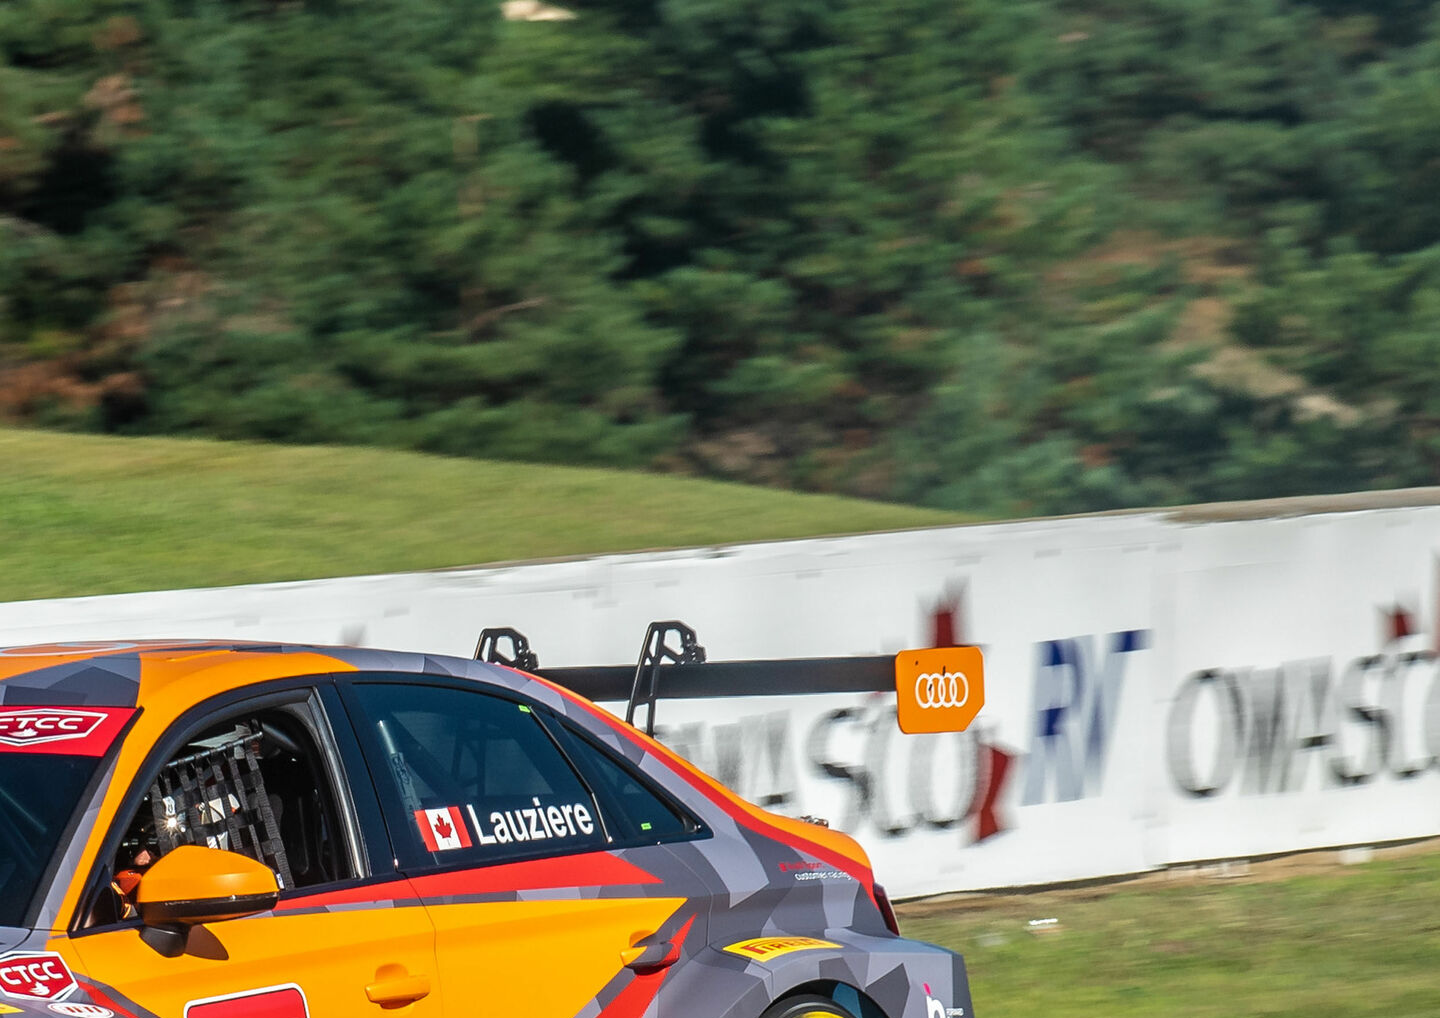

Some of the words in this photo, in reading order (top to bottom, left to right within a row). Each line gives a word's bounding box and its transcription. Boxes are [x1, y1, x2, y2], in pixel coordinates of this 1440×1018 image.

[658, 706, 988, 838] WASCO
[1022, 629, 1152, 806] RV
[466, 797, 594, 845] Lauziere
[0, 961, 63, 985] CTCC
